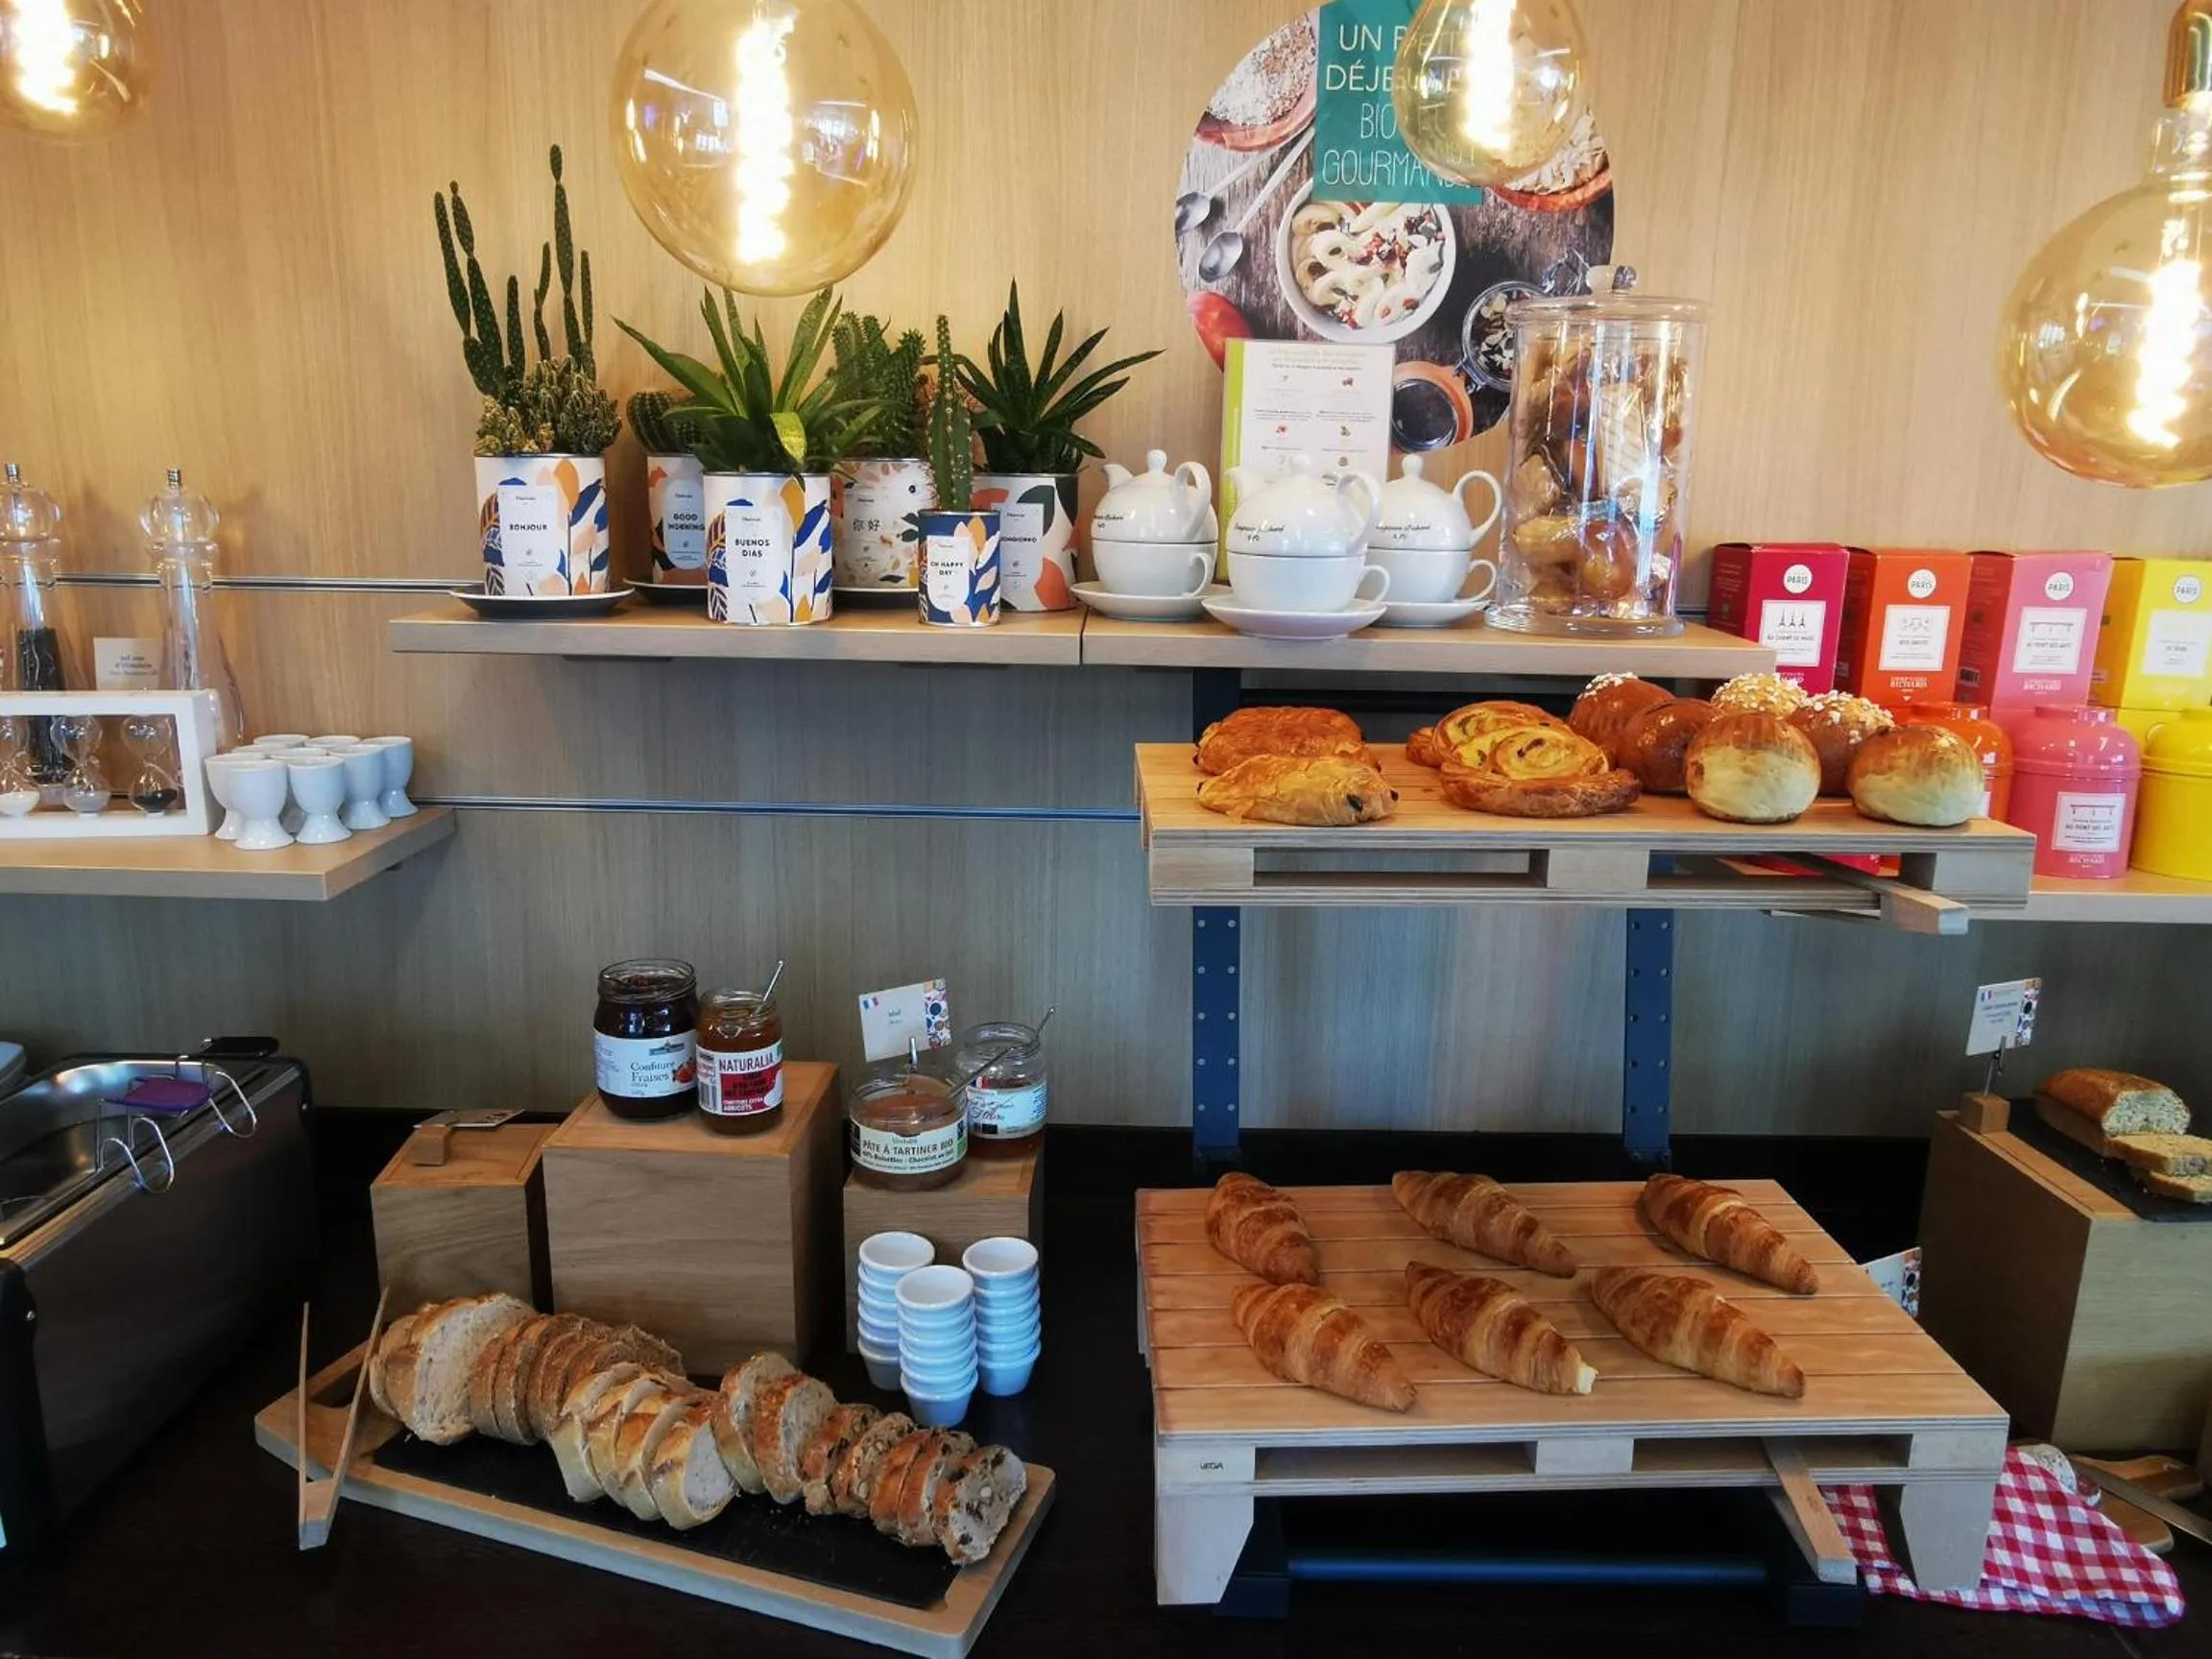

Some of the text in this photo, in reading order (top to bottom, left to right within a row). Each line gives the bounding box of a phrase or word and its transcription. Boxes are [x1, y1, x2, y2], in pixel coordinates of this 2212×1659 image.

[1339, 24, 1382, 52] UN
[1360, 103, 1399, 139] BIO
[673, 513, 698, 521] GOOD
[632, 1070, 670, 1082] Fraises
[893, 1143, 938, 1156] TARTINER
[941, 1138, 953, 1150] BIO
